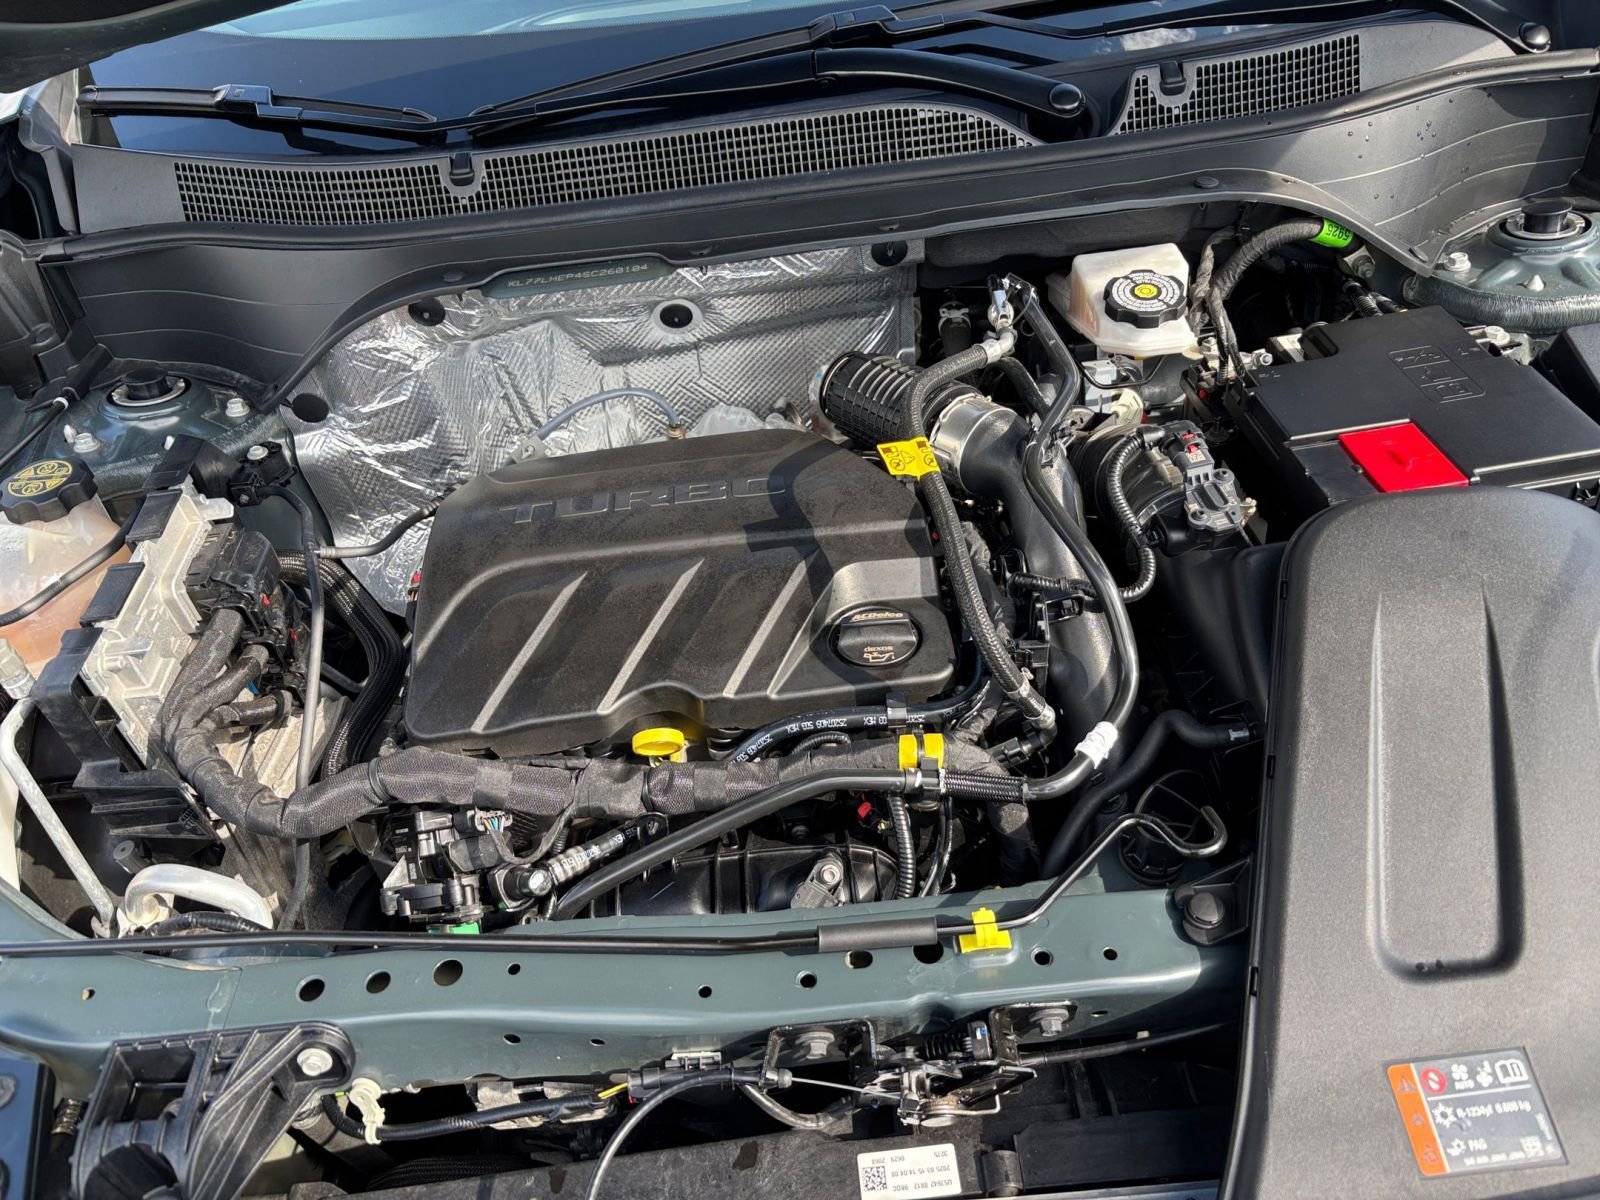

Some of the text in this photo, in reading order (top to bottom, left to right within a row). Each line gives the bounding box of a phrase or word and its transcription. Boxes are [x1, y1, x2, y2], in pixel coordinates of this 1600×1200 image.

[1326, 223, 1350, 241] 5925
[499, 477, 786, 525] TURBO
[863, 645, 894, 653] dexos
[785, 724, 801, 735] MEX
